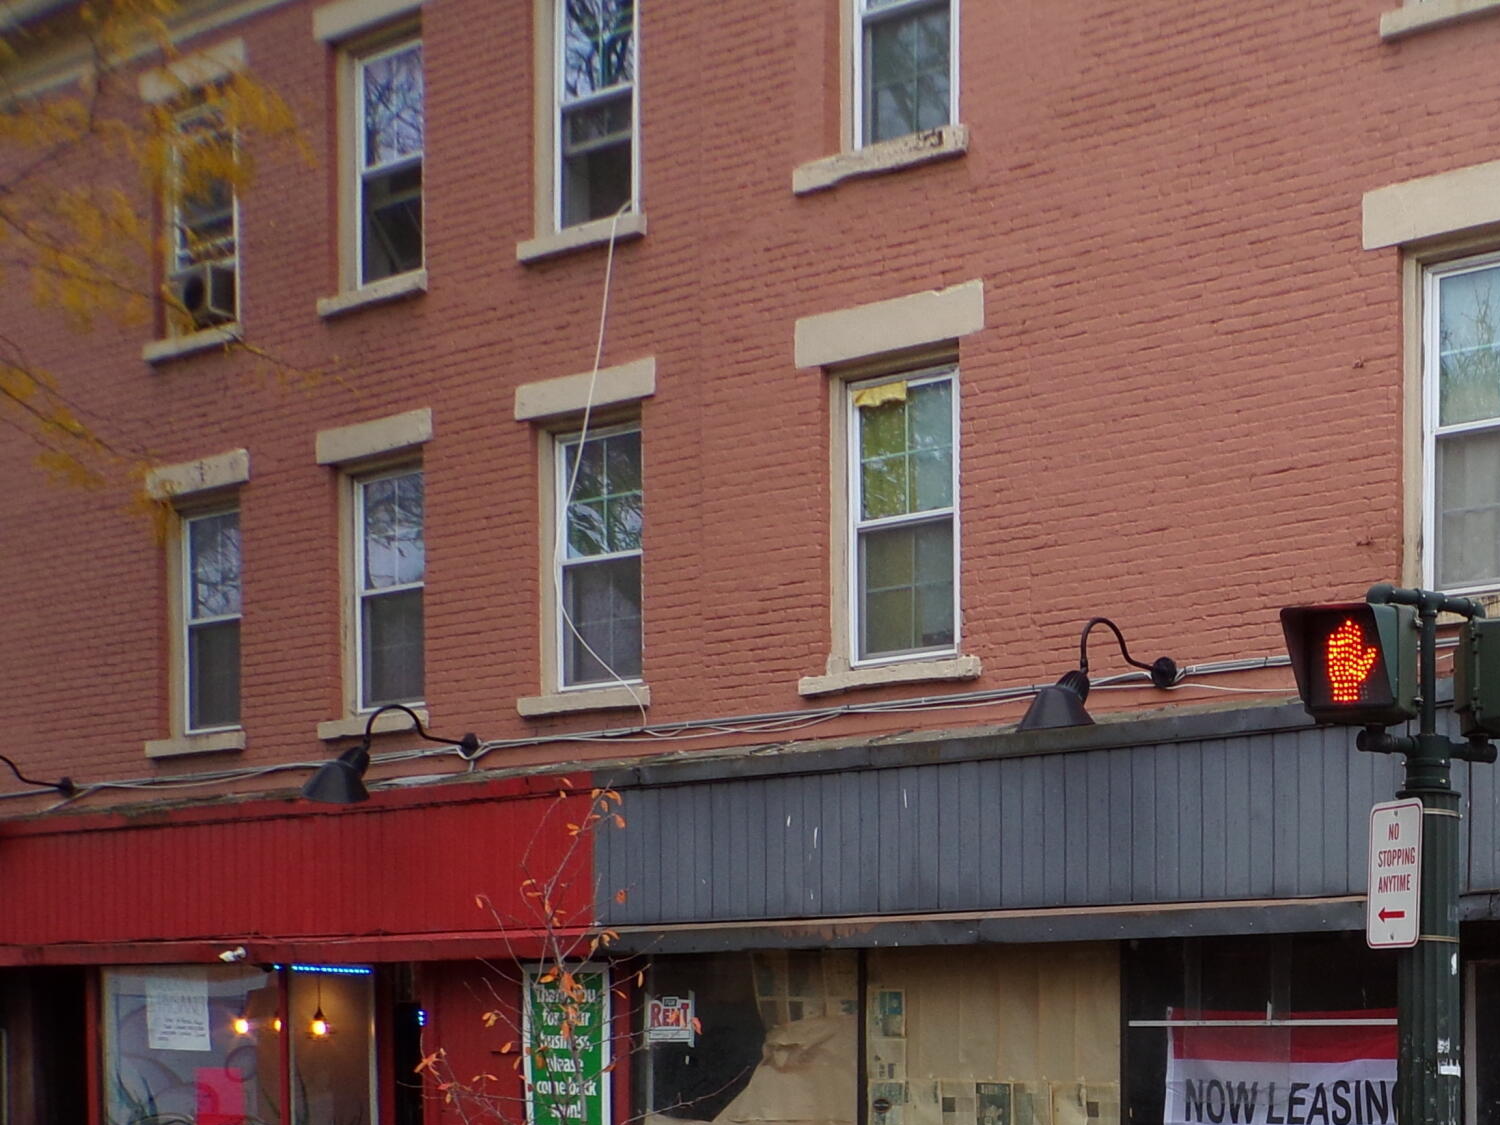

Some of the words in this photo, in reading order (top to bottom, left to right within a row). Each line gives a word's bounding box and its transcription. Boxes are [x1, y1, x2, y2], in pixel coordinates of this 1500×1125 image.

[1388, 823, 1400, 841] NO
[1378, 847, 1416, 868] STOPPING
[1378, 873, 1412, 894] ANYTIME
[542, 1007, 561, 1026] for
[540, 1030, 593, 1052] businss,
[1185, 1078, 1259, 1125] NOW
